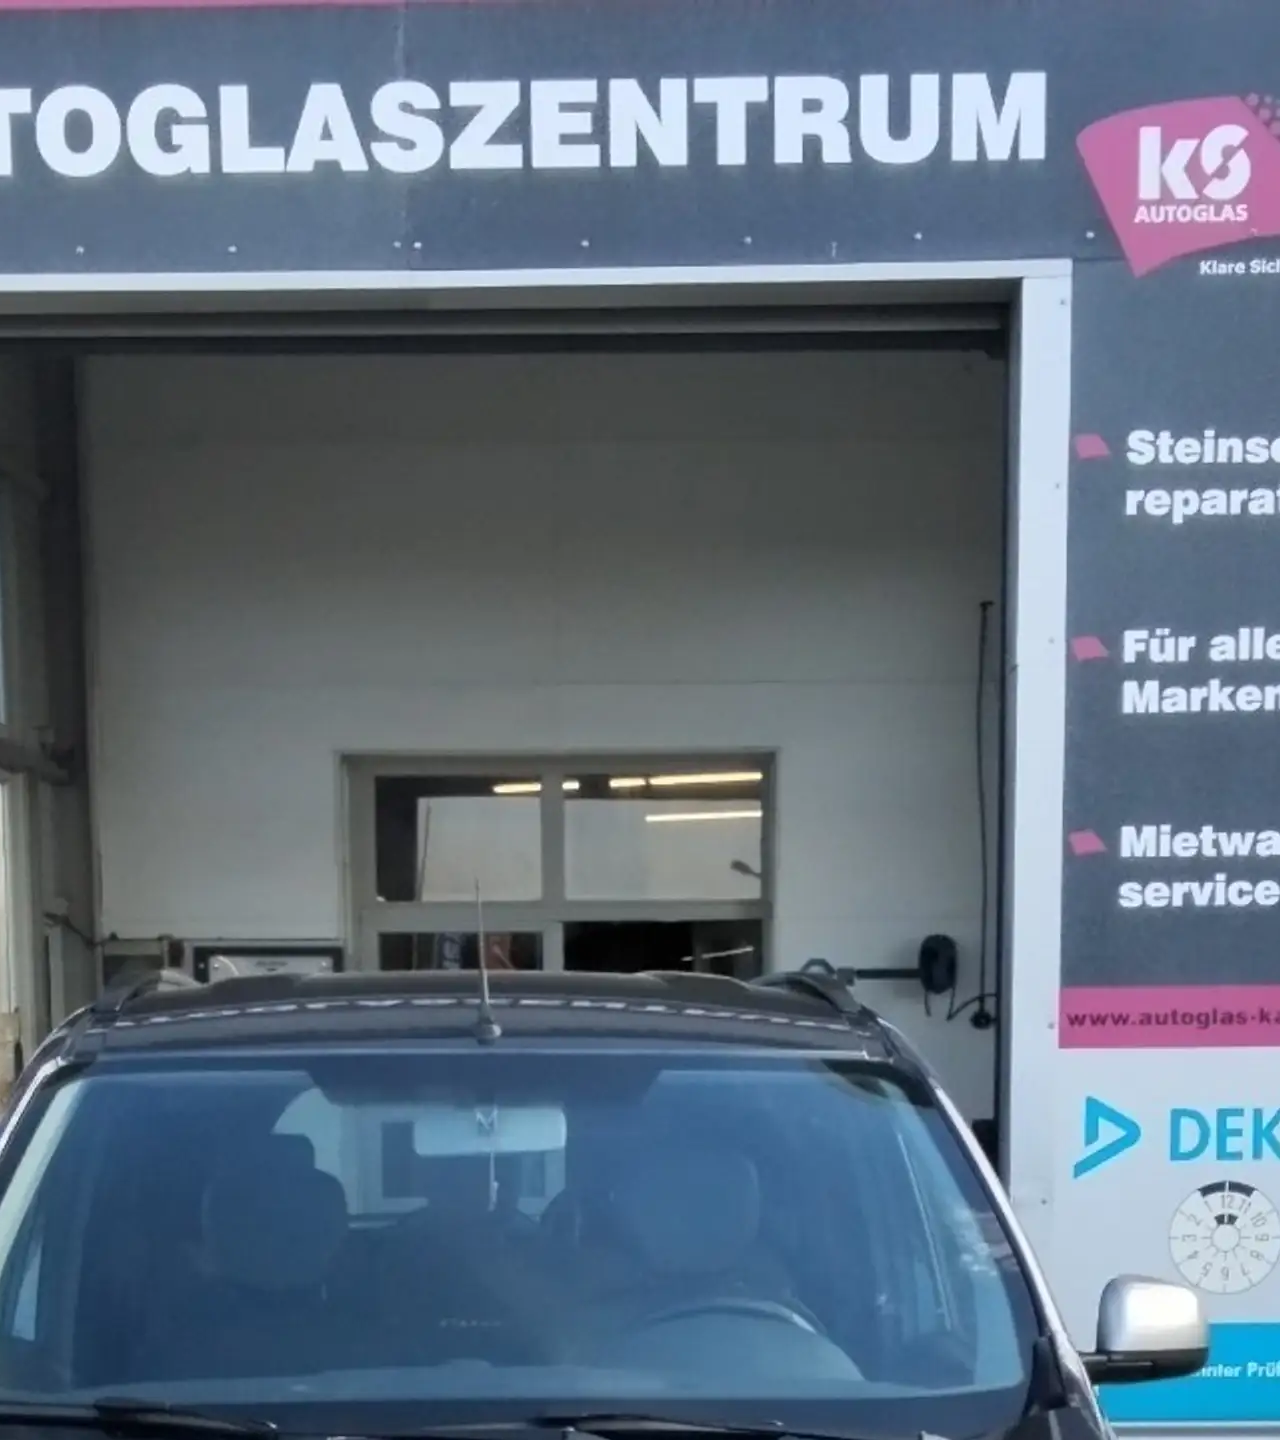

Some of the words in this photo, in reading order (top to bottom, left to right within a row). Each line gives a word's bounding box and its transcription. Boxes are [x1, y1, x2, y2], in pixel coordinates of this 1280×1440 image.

[1134, 203, 1249, 224] AUTOGLAS
[1199, 259, 1246, 276] Klare
[1122, 628, 1196, 664] Für
